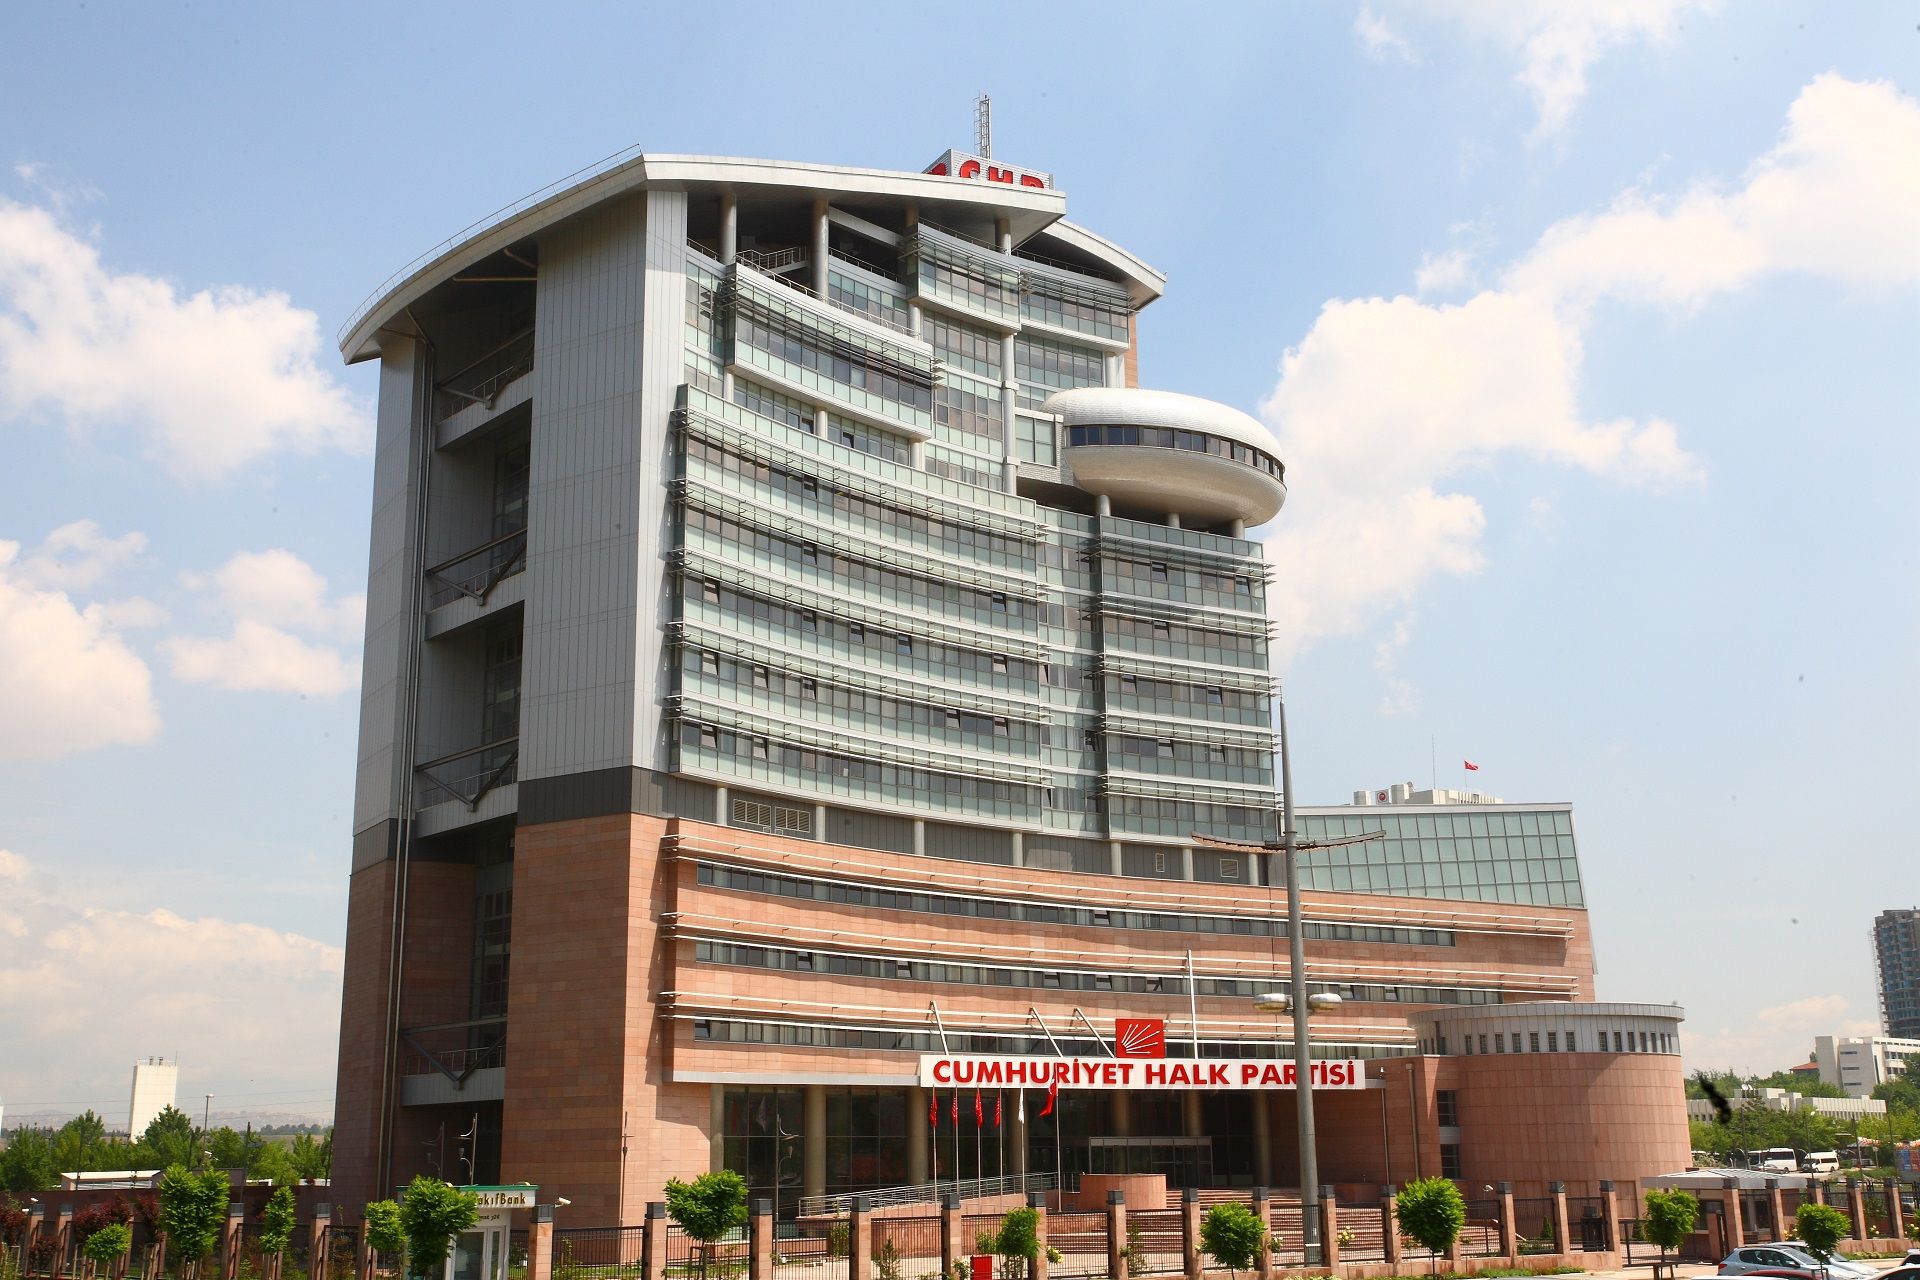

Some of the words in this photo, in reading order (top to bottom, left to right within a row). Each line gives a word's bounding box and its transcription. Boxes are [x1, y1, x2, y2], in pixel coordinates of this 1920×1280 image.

[933, 1058, 1134, 1085] CUMHURİYET
[1145, 1063, 1231, 1085] HALK
[1241, 1060, 1356, 1086] PARTİSİ
[478, 1192, 526, 1205] akıfBank
